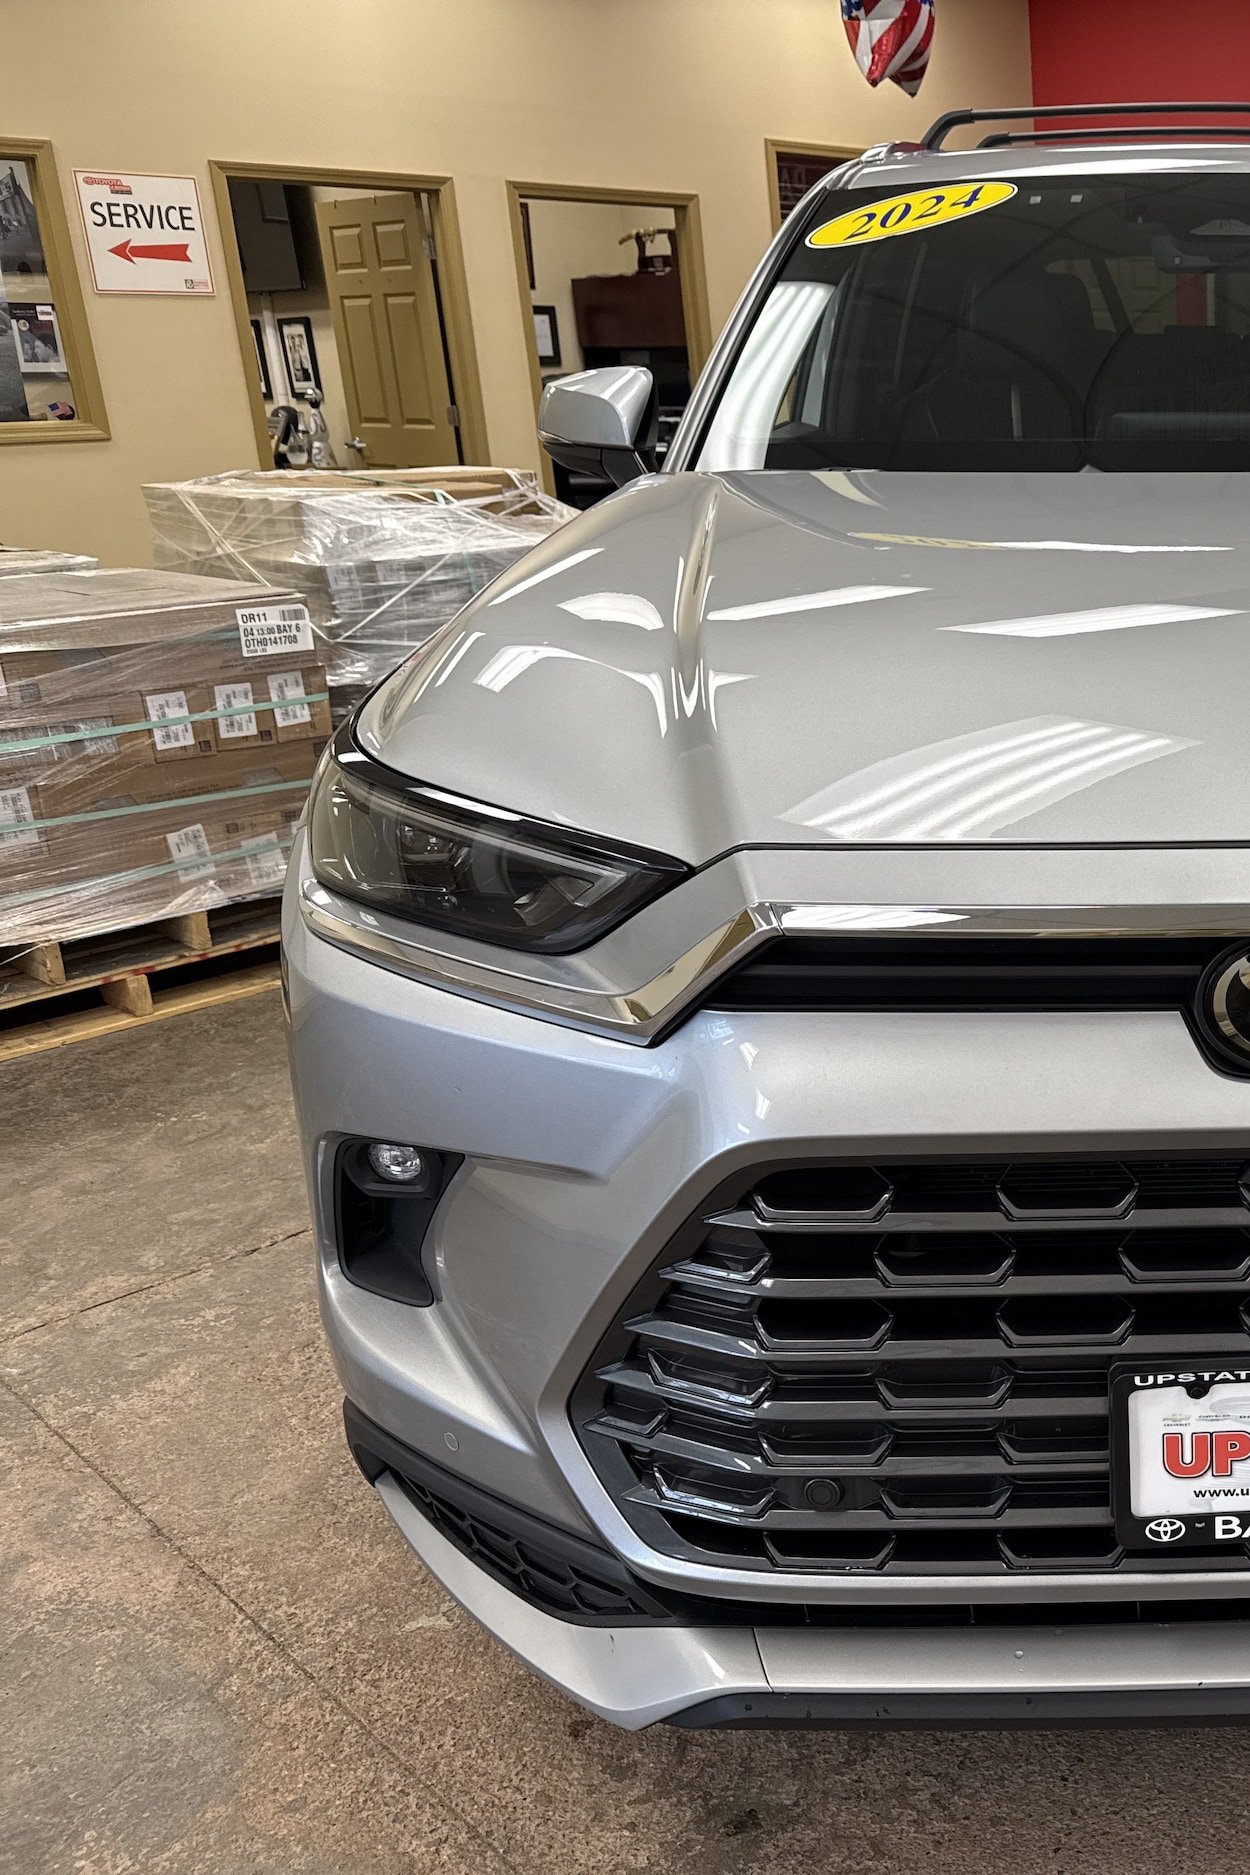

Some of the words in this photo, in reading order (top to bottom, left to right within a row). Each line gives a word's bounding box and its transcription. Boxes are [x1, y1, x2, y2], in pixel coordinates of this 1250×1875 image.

[90, 201, 195, 231] SERVICE
[843, 185, 986, 242] 2024
[241, 612, 267, 624] DR11
[243, 628, 254, 638] 04
[256, 627, 276, 636] 13:00
[276, 624, 293, 634] BAY
[295, 623, 301, 632] 6
